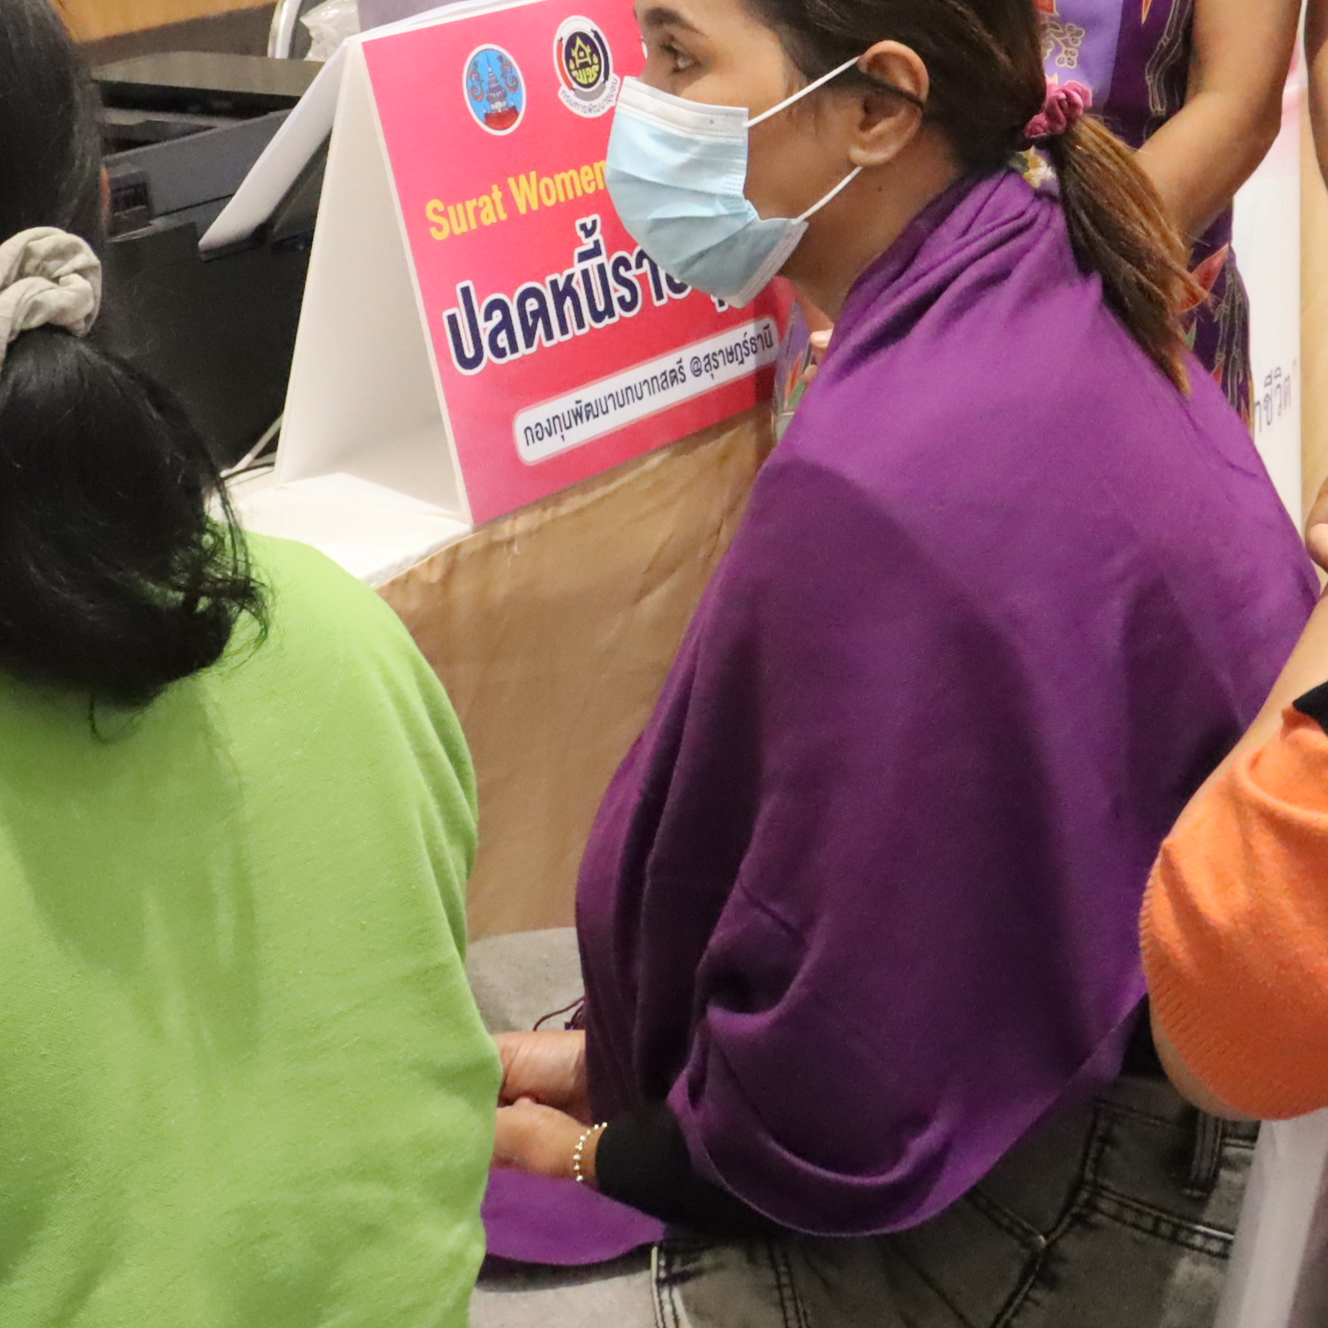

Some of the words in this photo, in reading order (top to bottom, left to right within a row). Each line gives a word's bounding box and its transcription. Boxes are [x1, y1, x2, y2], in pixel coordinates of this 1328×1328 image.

[425, 189, 508, 241] Surat
[523, 355, 686, 447] กองทุนพัฒนาบทบาทสตรี
[689, 324, 774, 381] @สุราษฎร์ธานี
